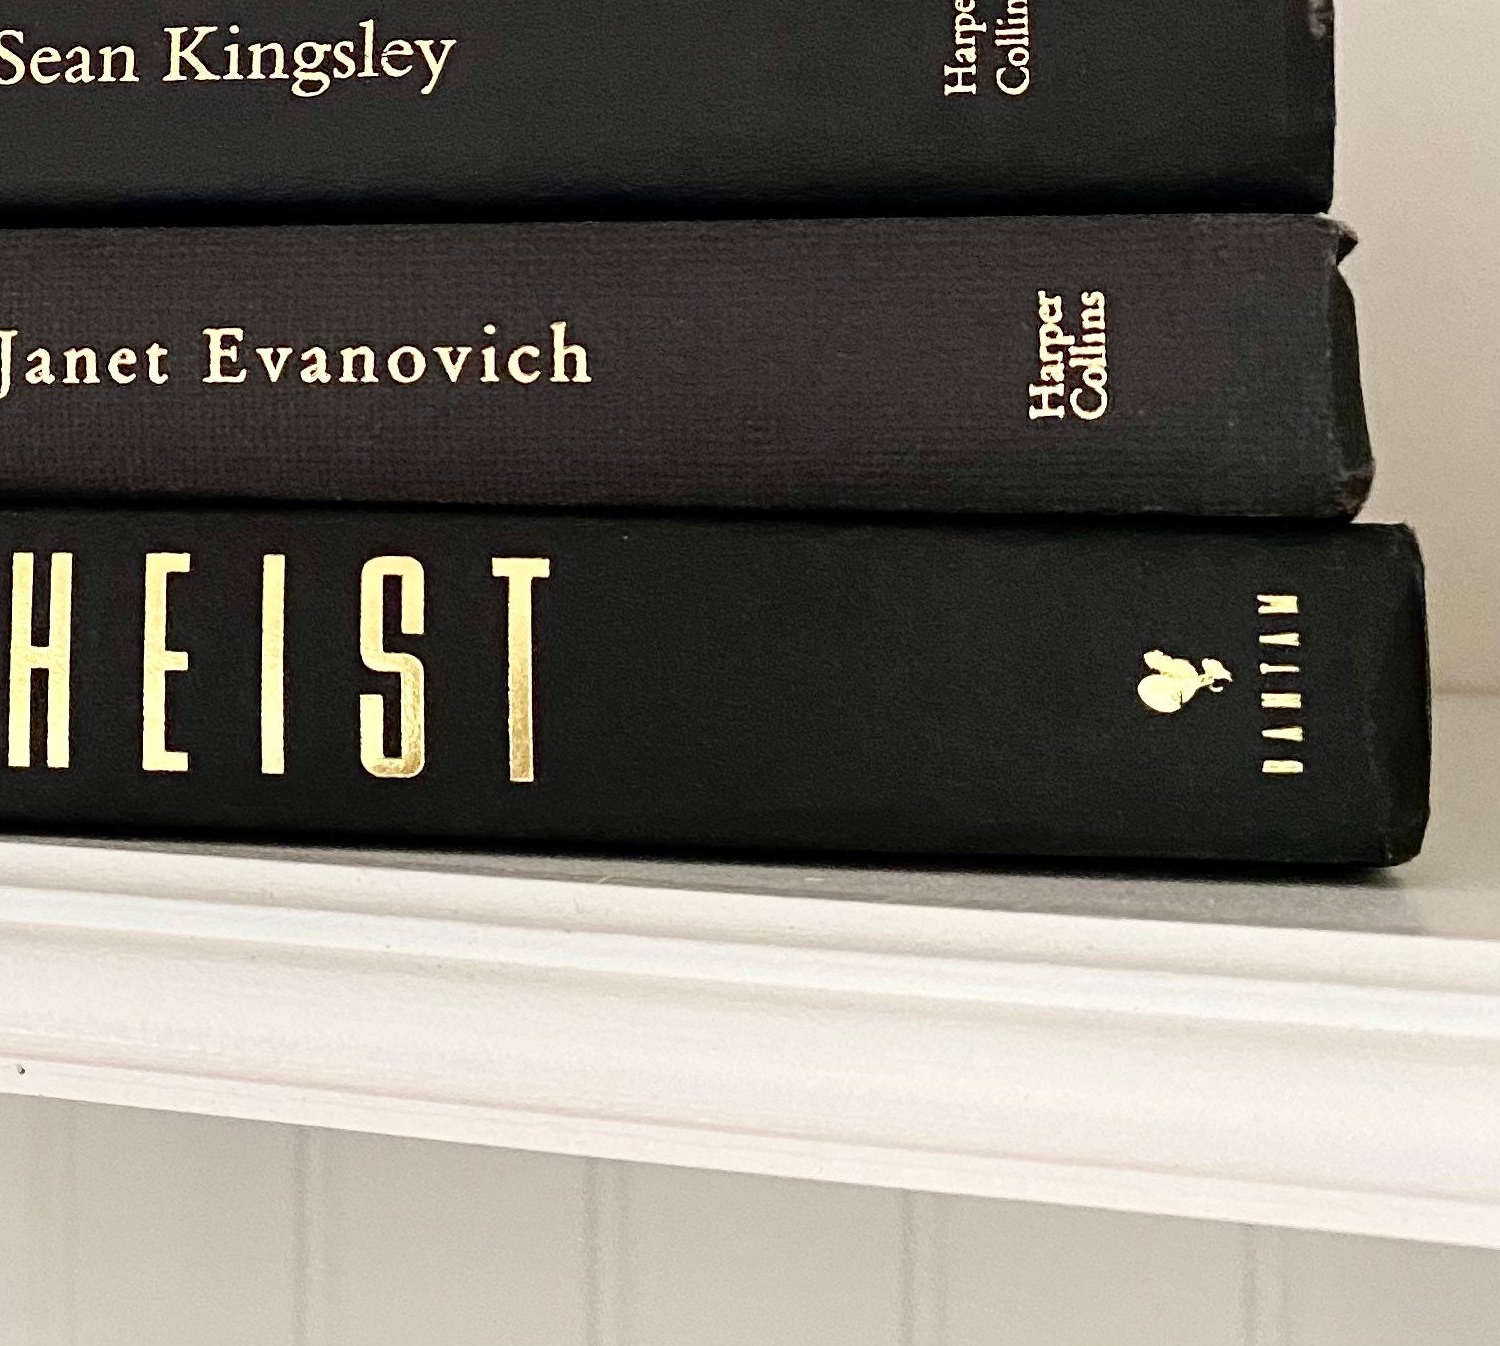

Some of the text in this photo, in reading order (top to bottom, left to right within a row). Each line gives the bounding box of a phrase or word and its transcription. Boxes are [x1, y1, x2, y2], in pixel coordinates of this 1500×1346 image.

[163, 19, 457, 97] Kingsley
[203, 322, 591, 383] Evanovich
[1029, 290, 1075, 420] Harper
[1068, 291, 1108, 420] Collins
[8, 552, 550, 782] HEIST
[1257, 595, 1303, 773] BANTAM
